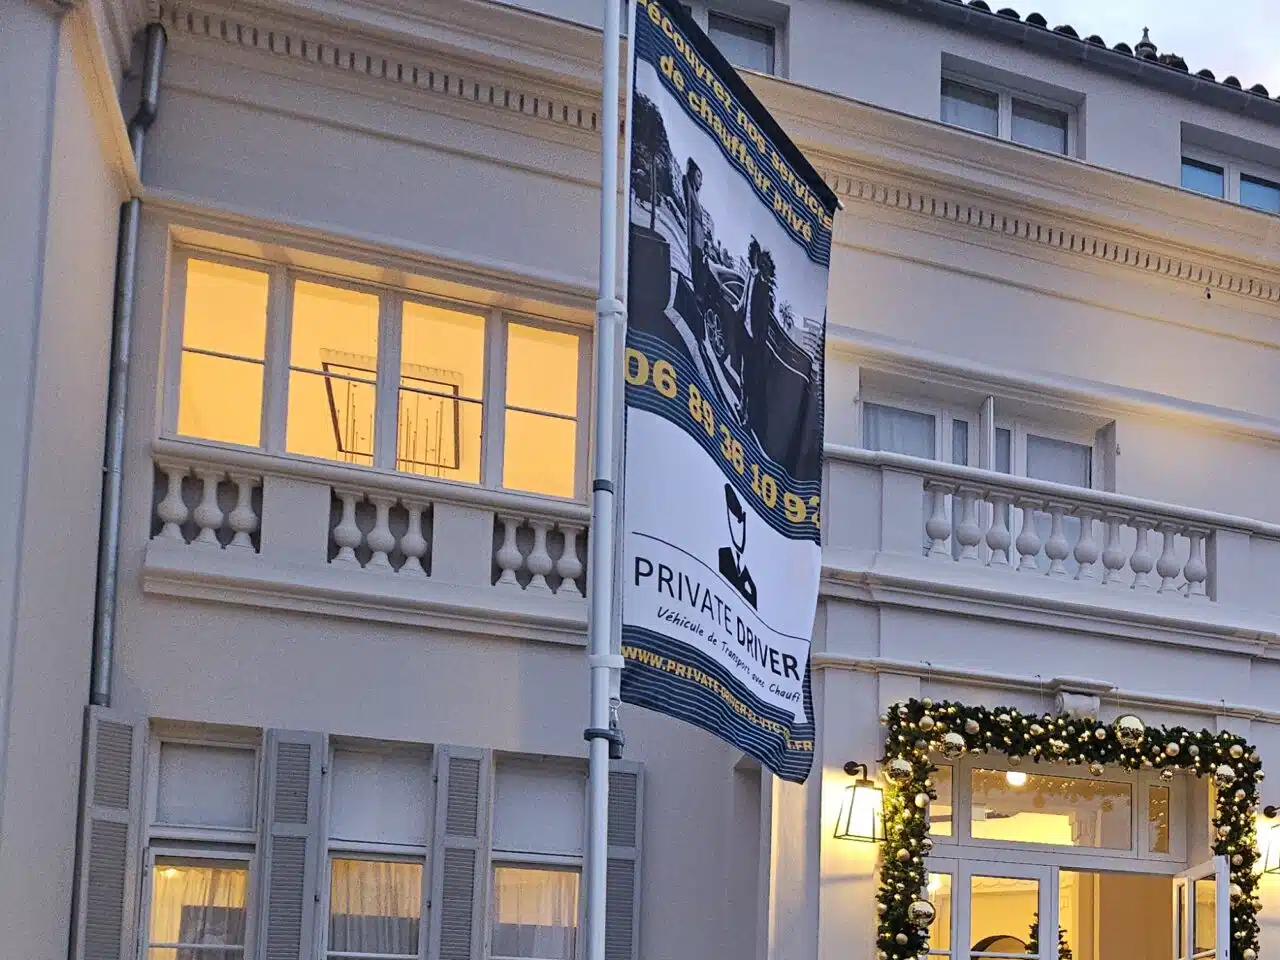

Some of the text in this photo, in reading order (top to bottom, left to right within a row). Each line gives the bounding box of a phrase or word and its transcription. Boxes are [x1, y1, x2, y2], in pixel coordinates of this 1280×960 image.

[660, 55, 812, 242] de chauffeur privé
[737, 110, 766, 153] nos
[624, 348, 678, 398] 06
[719, 424, 745, 475] 36
[751, 464, 777, 509] 10
[635, 556, 800, 682] PRIVATE DRIVER
[657, 606, 704, 637] Véhicule
[707, 632, 718, 645] de
[721, 641, 750, 675] Transport
